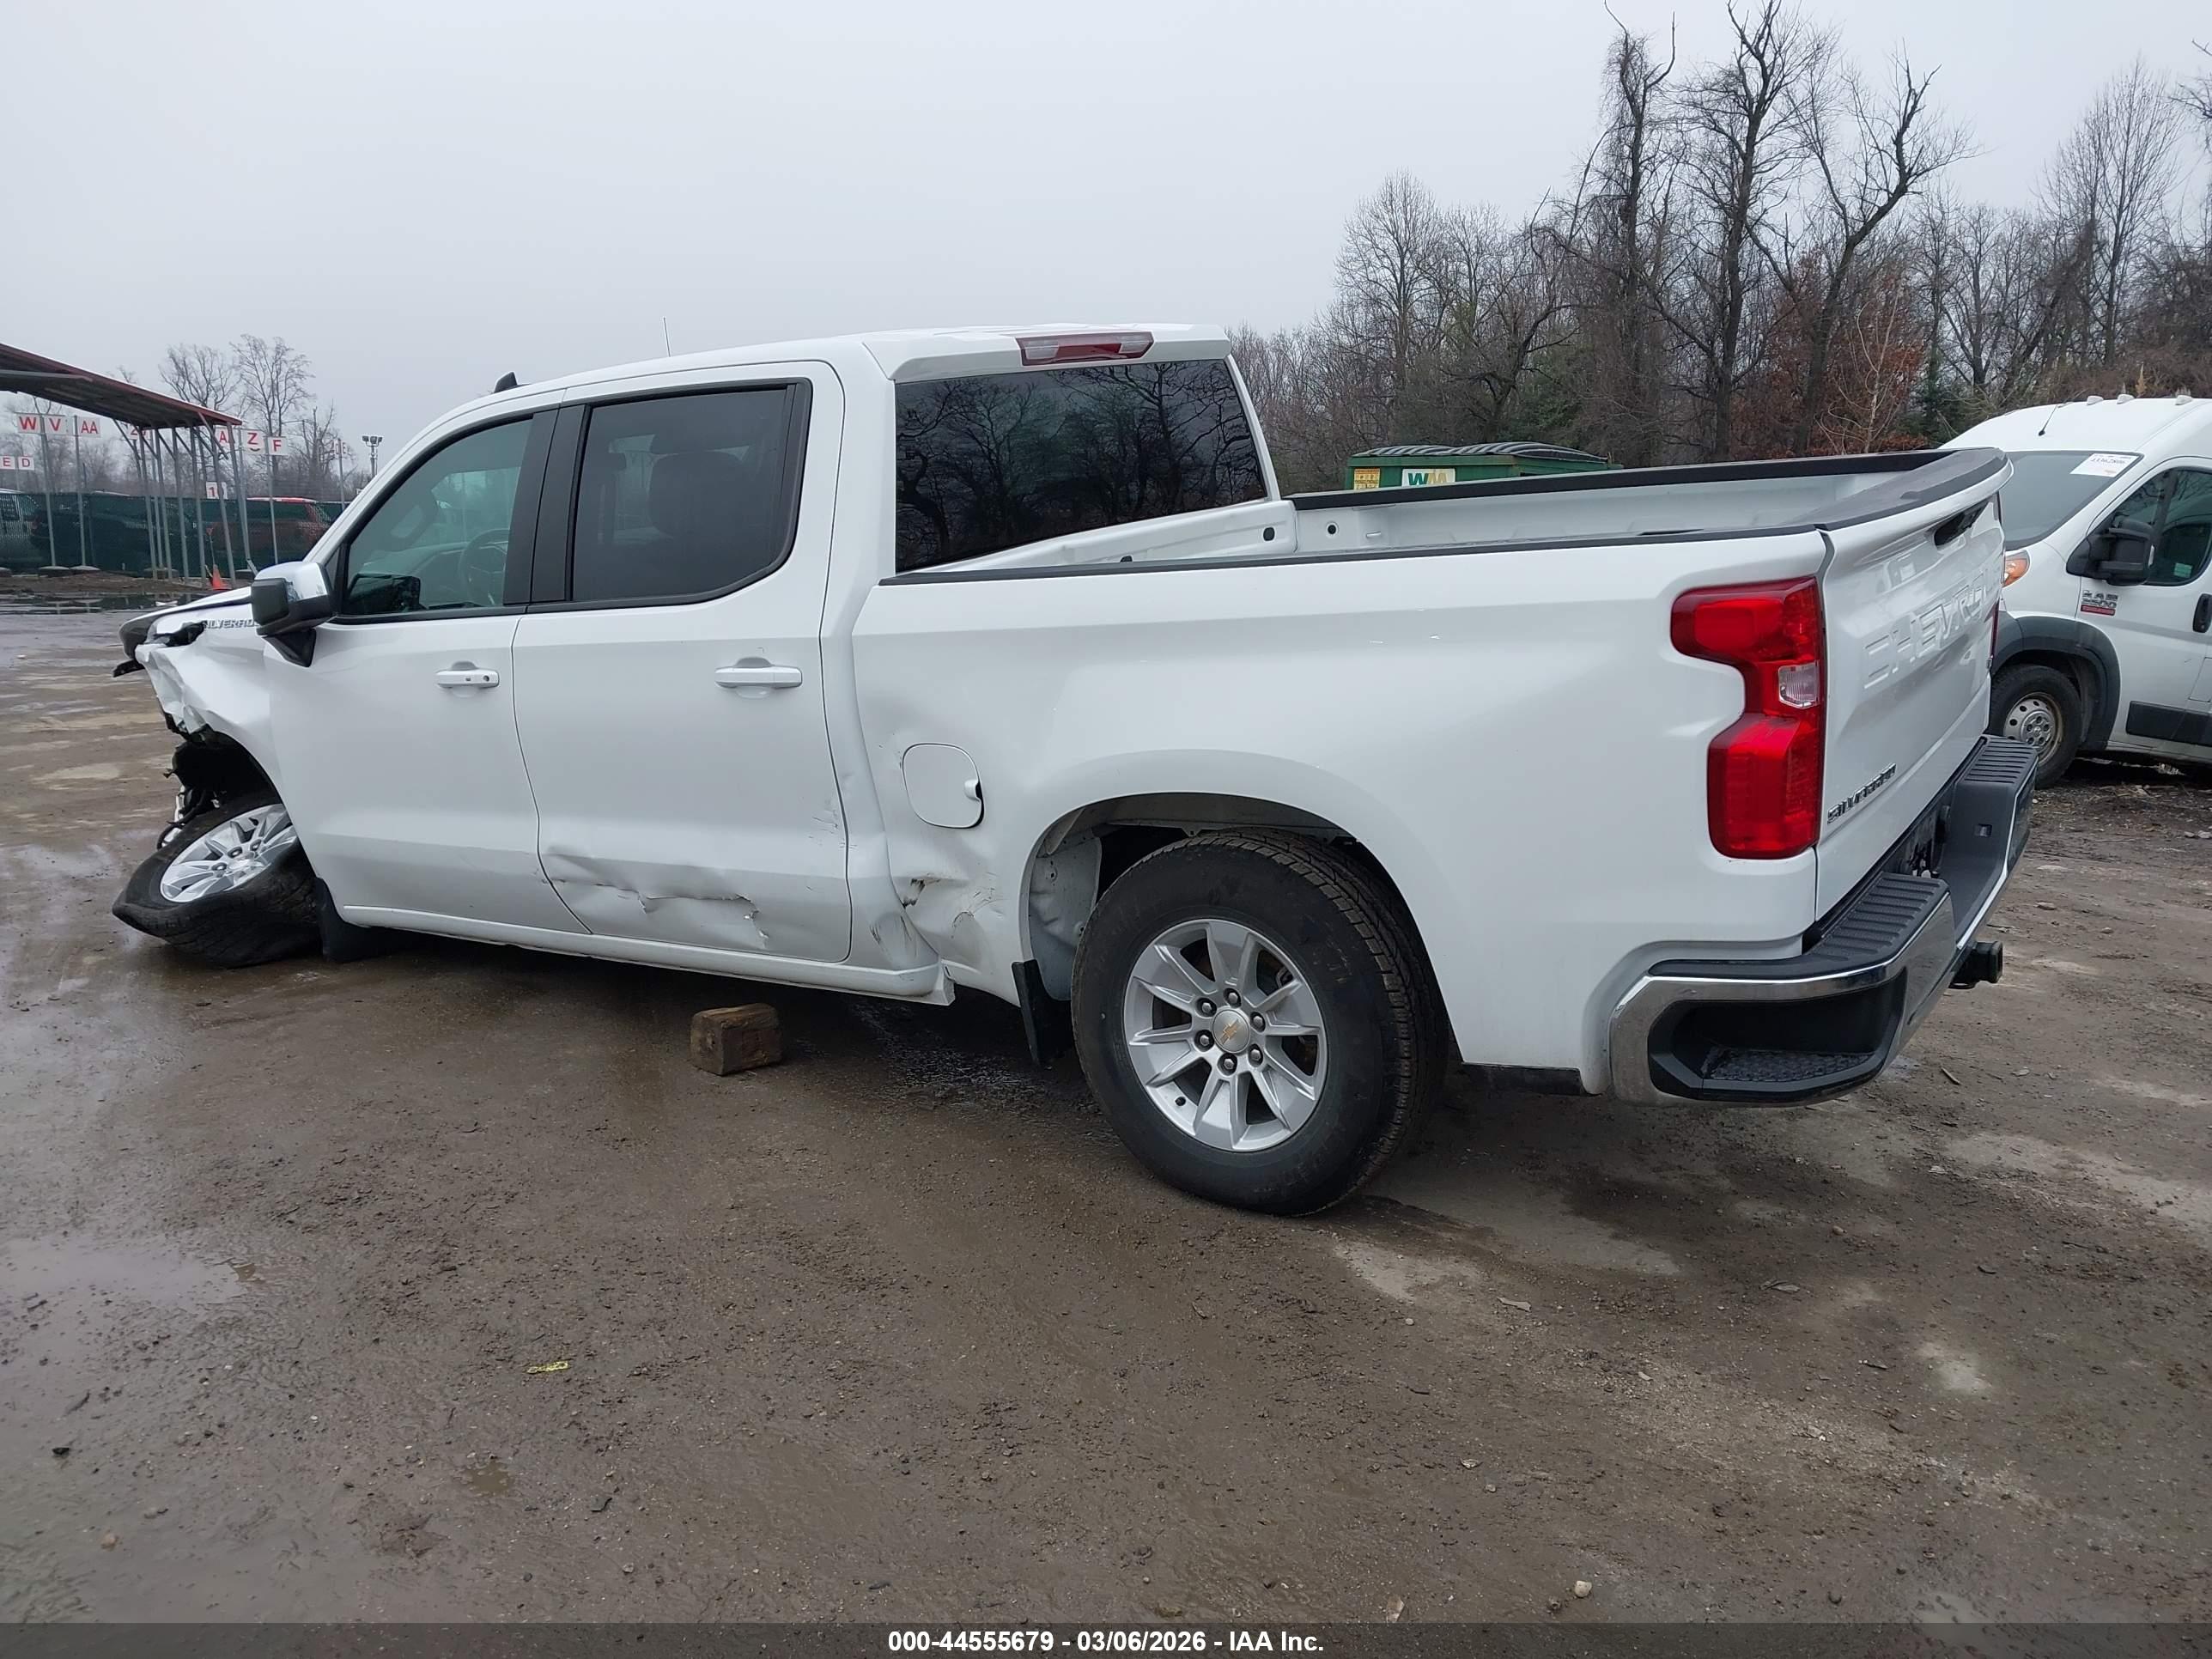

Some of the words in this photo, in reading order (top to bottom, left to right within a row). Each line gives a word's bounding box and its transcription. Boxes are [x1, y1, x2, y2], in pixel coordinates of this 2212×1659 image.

[18, 416, 37, 430] W
[48, 417, 61, 432] V
[80, 420, 99, 434] AA
[247, 432, 259, 446] Z
[272, 439, 283, 453] F
[2, 457, 11, 467] E
[21, 458, 31, 468] D
[1407, 472, 1448, 486] WM
